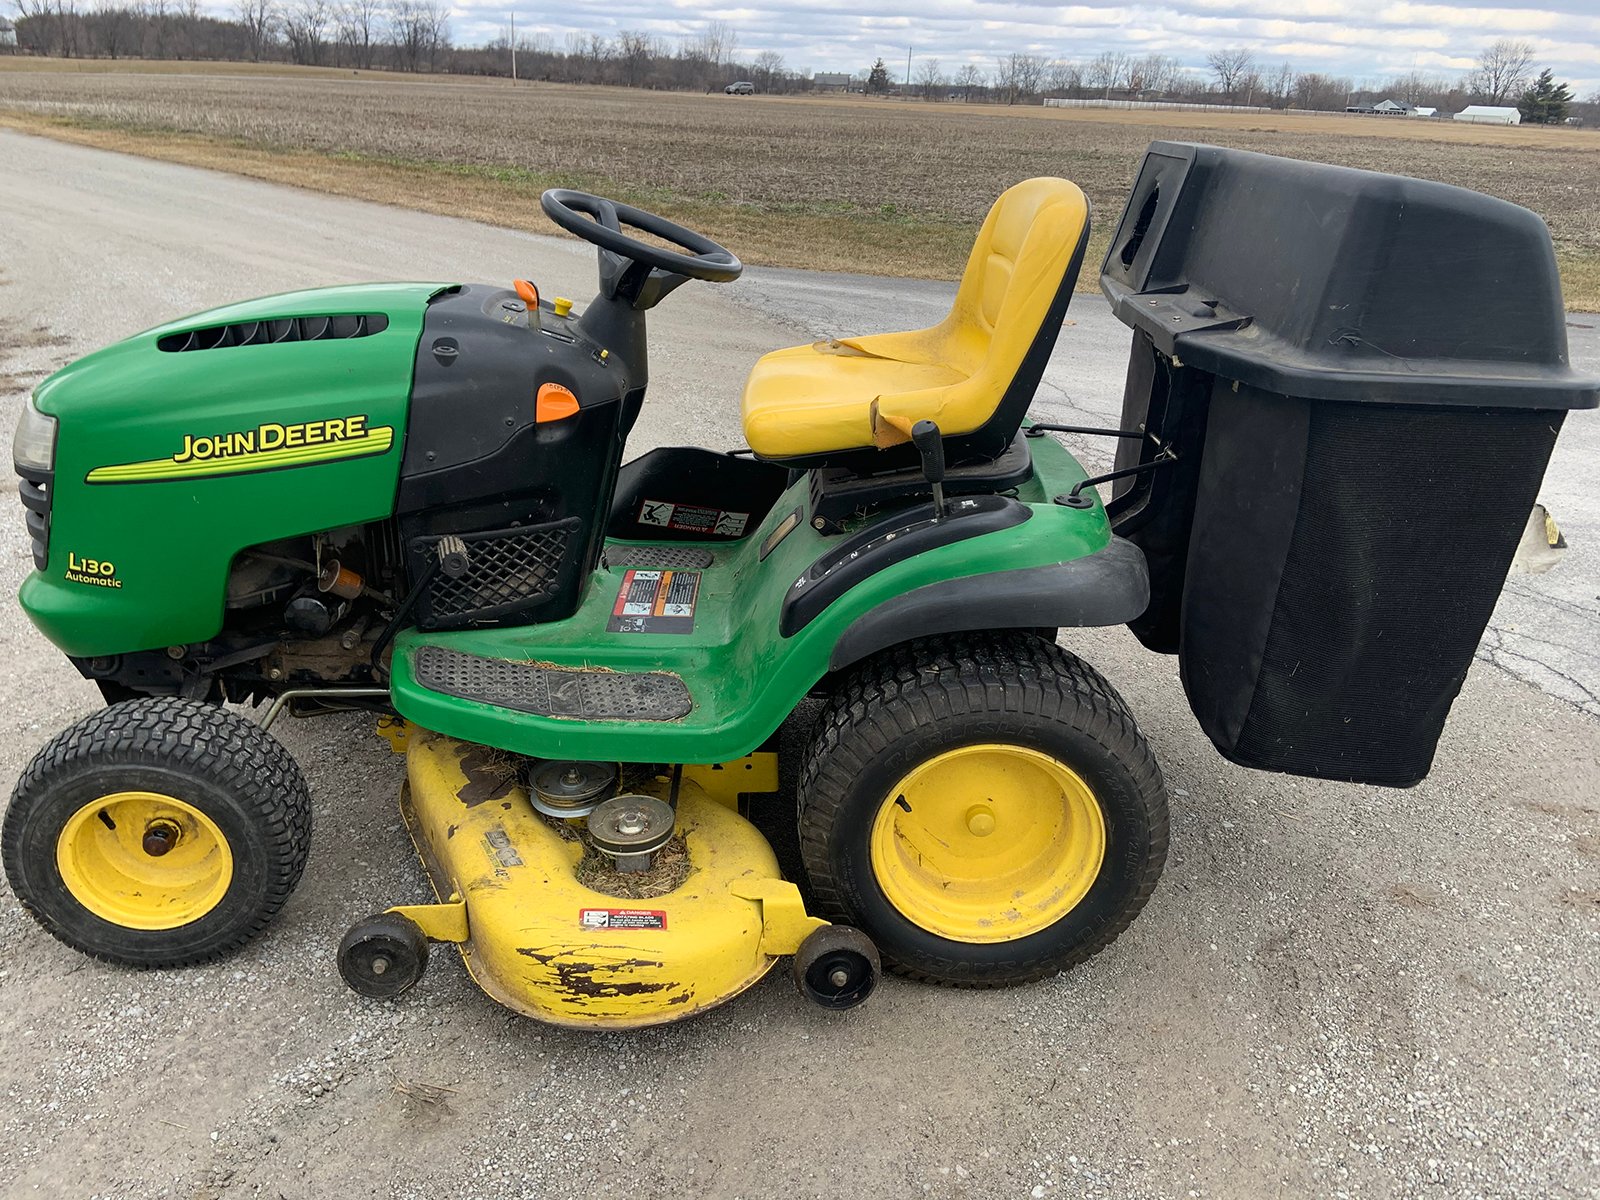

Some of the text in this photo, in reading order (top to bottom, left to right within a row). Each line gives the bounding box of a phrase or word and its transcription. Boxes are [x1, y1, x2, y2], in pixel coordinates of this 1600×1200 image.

[173, 415, 367, 463] JOHN DEERE
[68, 551, 115, 576] L130
[65, 570, 122, 589] Automatic
